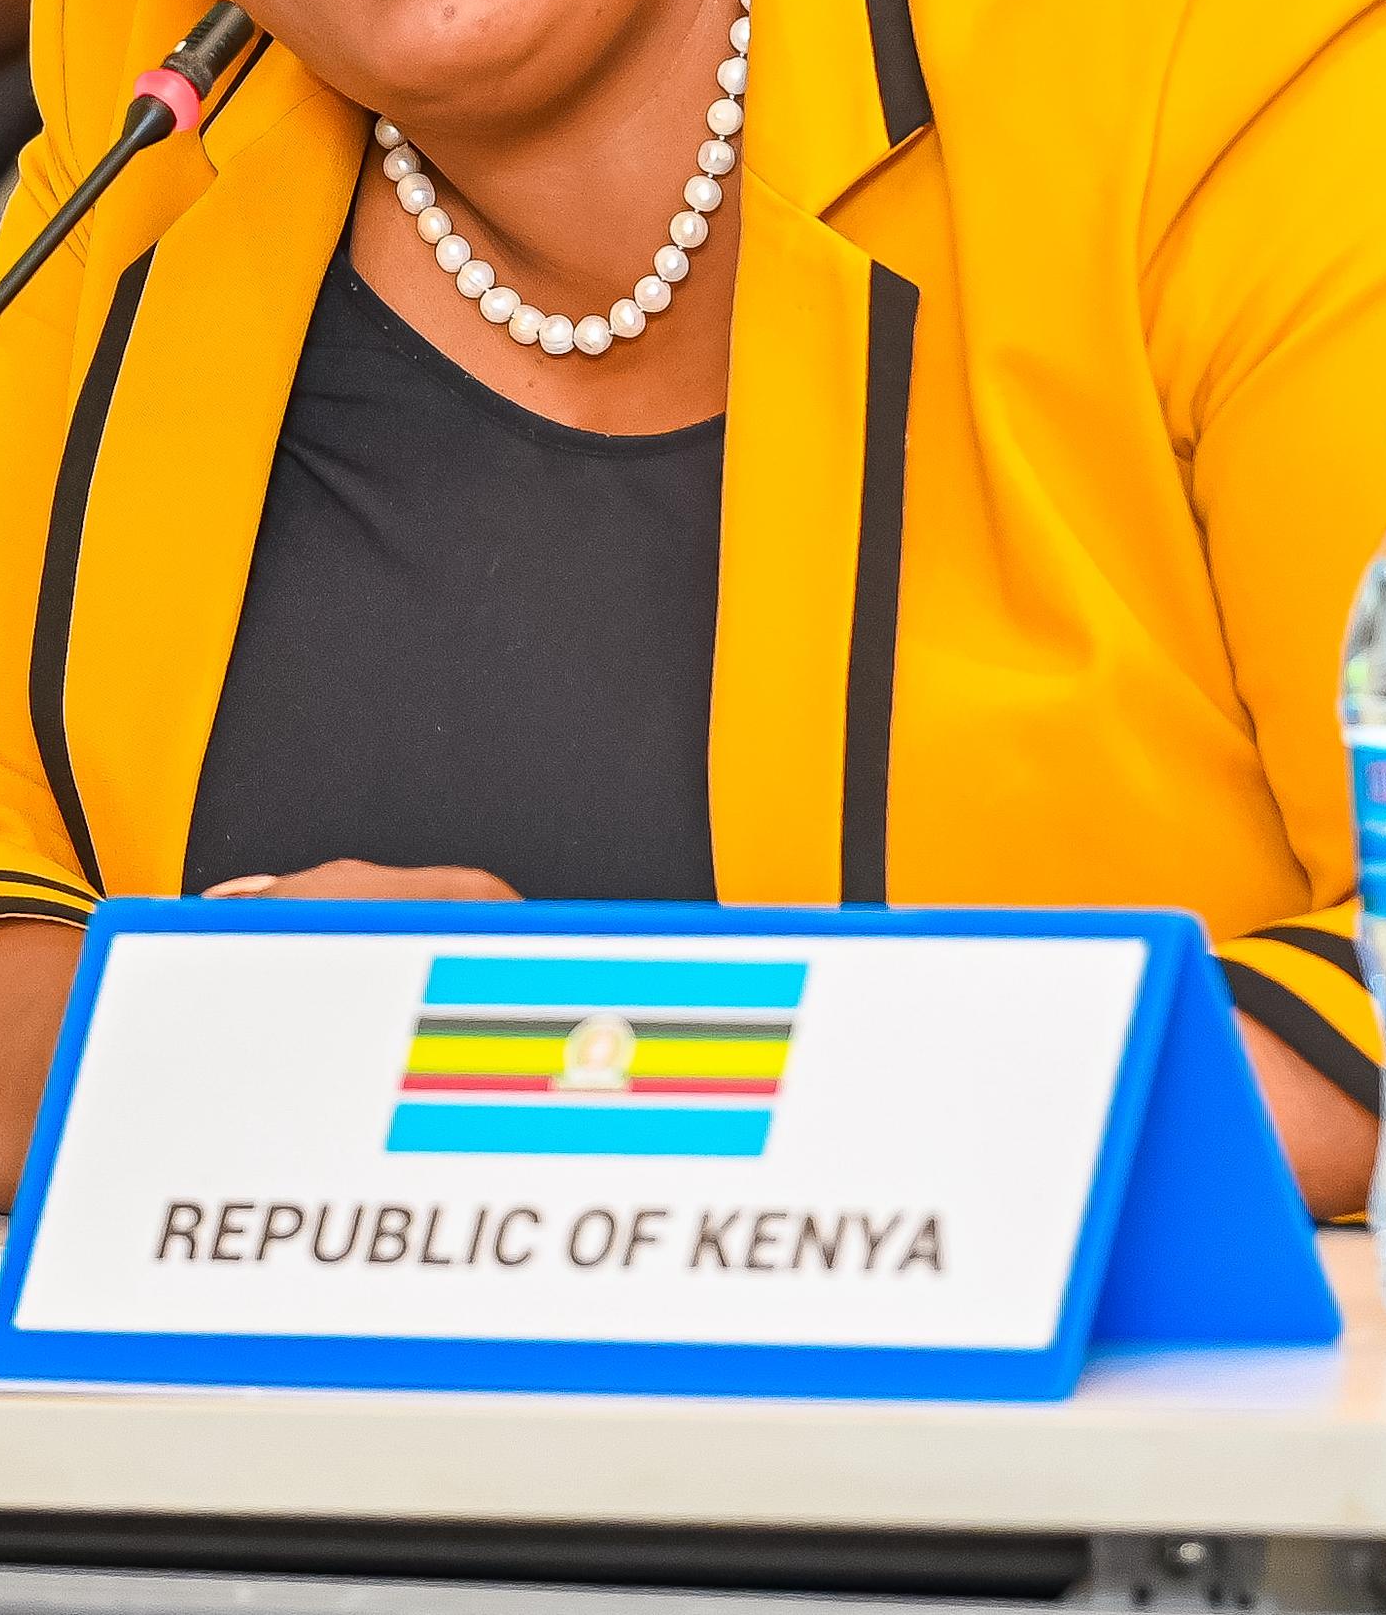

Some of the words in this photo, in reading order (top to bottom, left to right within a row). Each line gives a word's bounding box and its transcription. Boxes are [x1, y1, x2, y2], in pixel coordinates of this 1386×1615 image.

[155, 1200, 539, 1267] REPUBLIC
[568, 1208, 666, 1268] OF
[690, 1210, 945, 1272] KENYA
